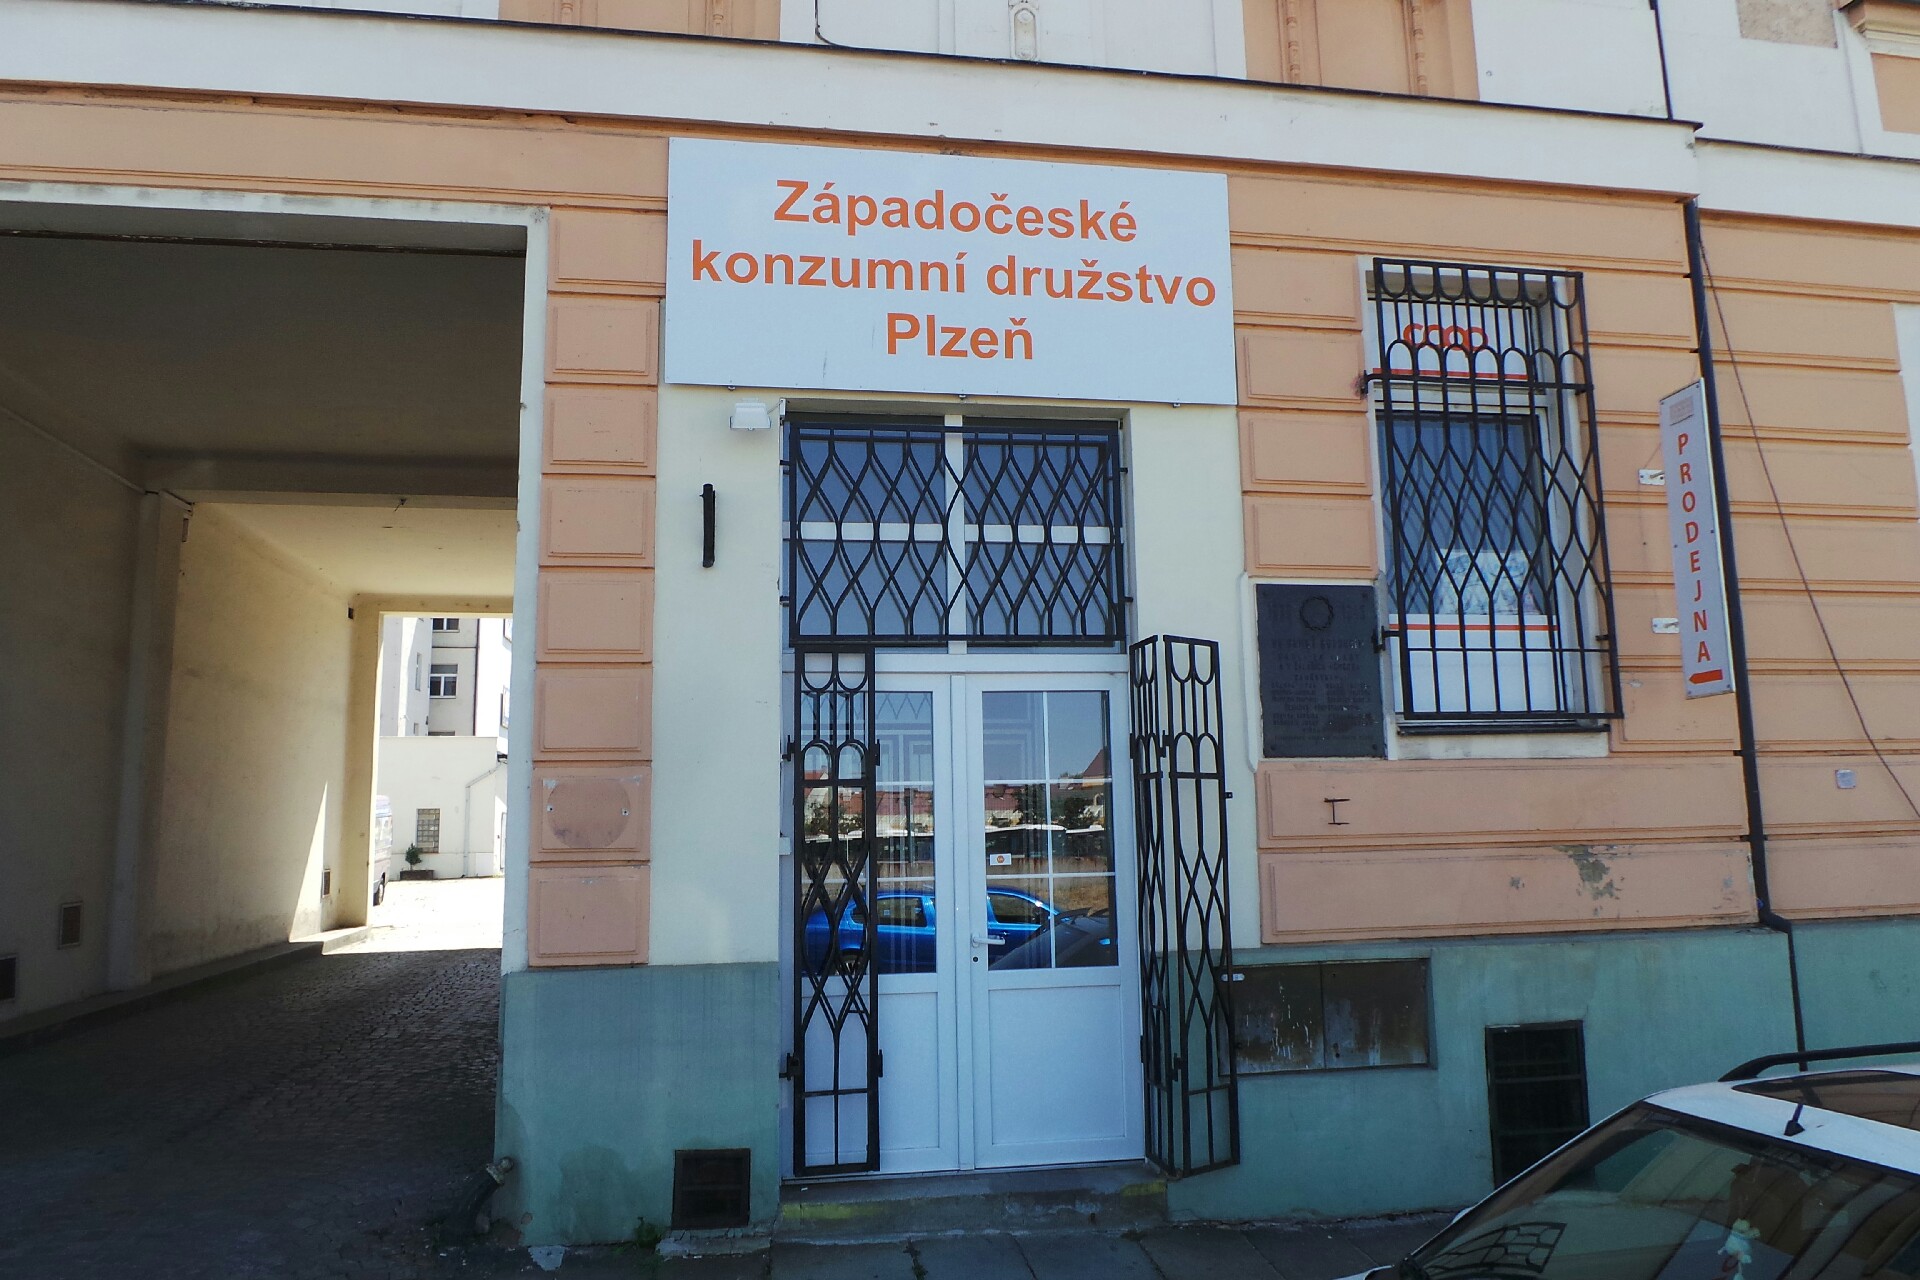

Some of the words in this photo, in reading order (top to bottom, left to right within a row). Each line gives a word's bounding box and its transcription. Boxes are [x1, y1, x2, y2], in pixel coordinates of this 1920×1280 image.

[774, 180, 1137, 241] Západočeské
[692, 239, 967, 294] konzumní
[987, 254, 1216, 307] družstvo
[887, 313, 1033, 360] Plzeň
[1677, 432, 1711, 663] PRODEJNA
